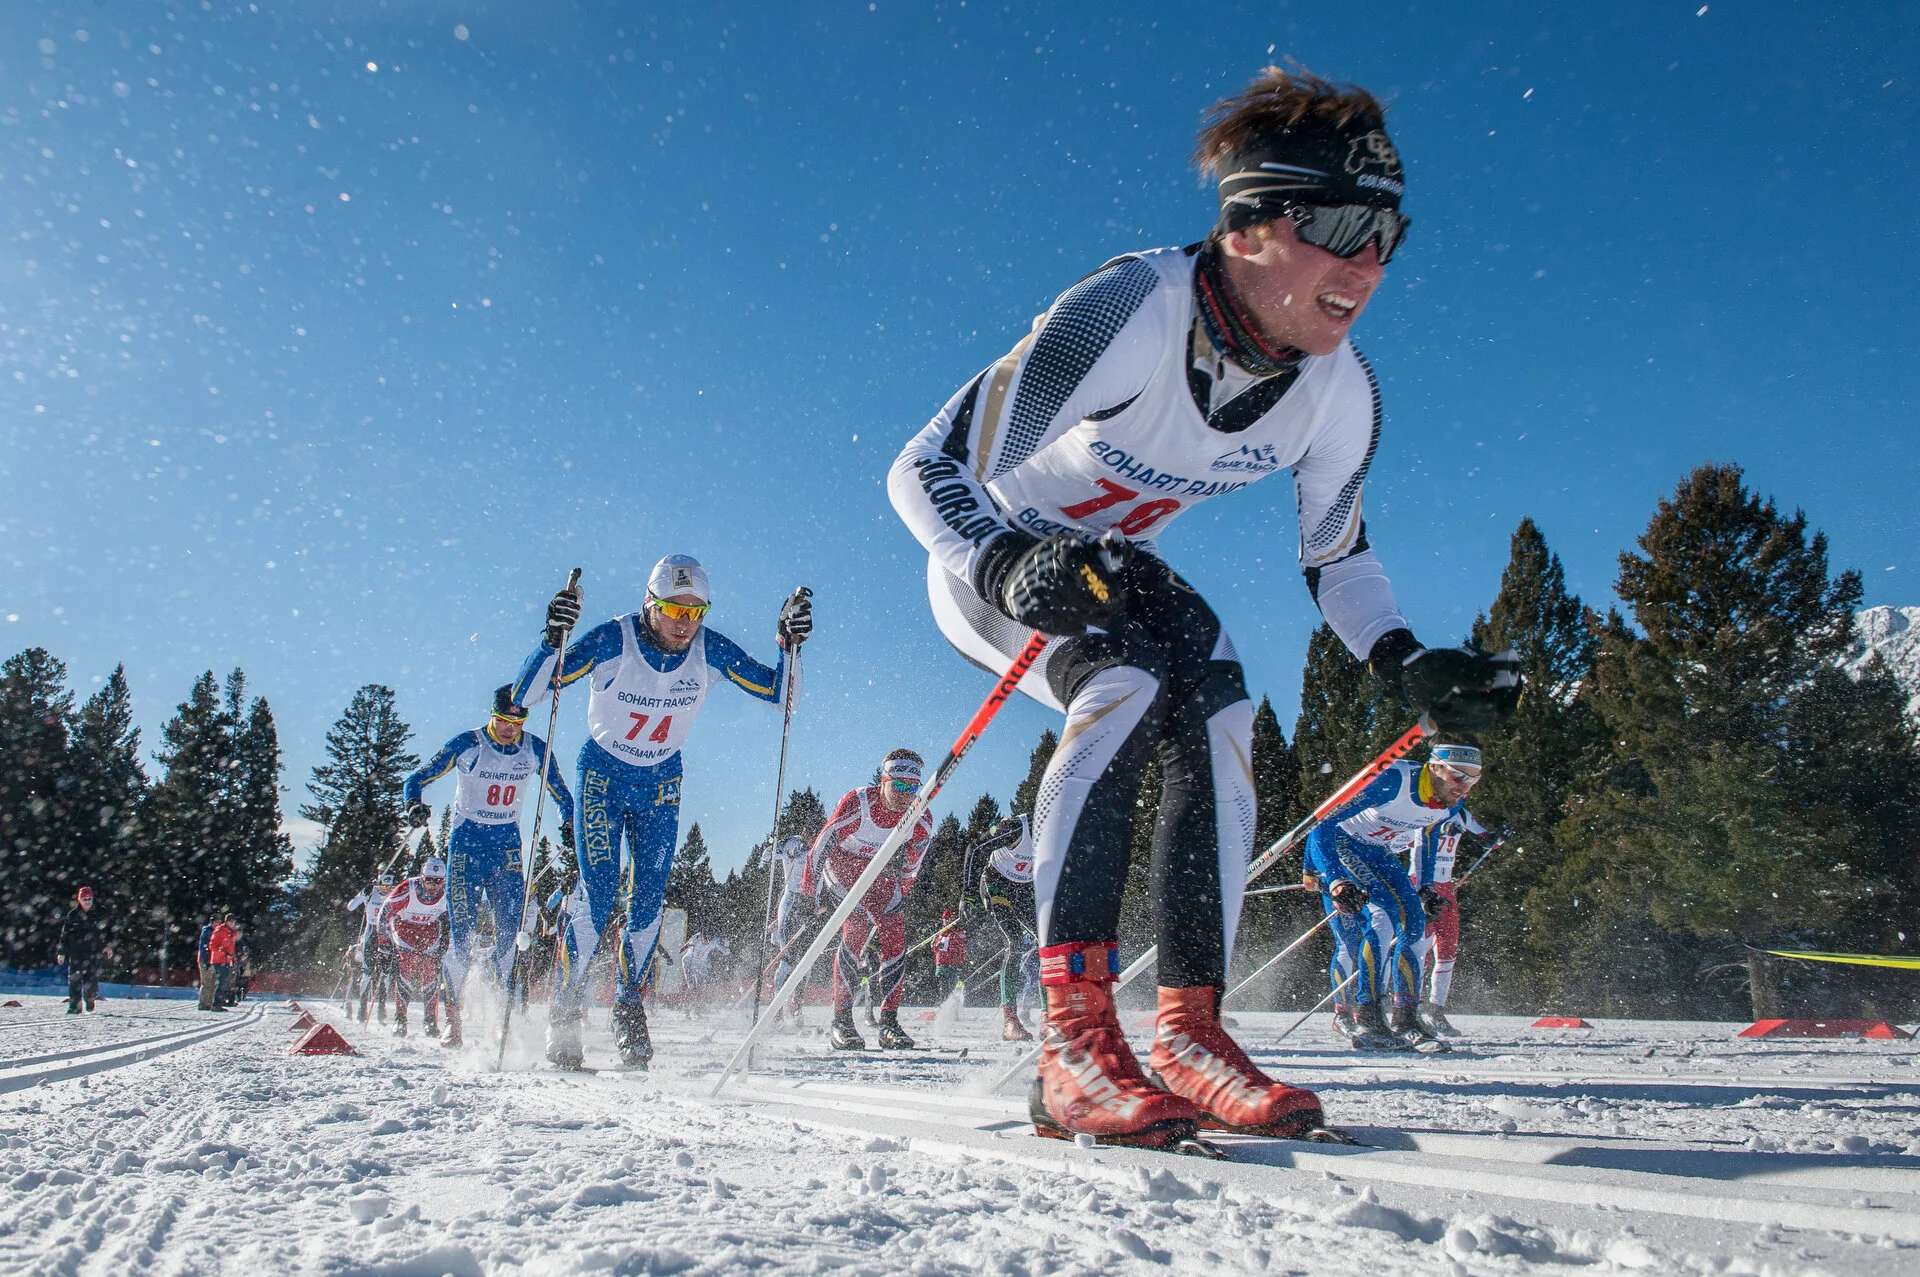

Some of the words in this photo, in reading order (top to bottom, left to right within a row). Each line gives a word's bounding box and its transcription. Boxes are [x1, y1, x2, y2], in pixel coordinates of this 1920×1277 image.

[1088, 441, 1188, 491] BOHART
[1181, 480, 1250, 497] RANC
[1059, 477, 1181, 536] 70
[618, 691, 662, 708] BOHART
[663, 695, 698, 708] RANCH
[624, 712, 673, 743] 74
[612, 740, 656, 759] BOZEMAN
[656, 747, 672, 757] MT
[479, 770, 508, 781] BOHART
[486, 784, 517, 806] 80
[1437, 836, 1455, 853] 79
